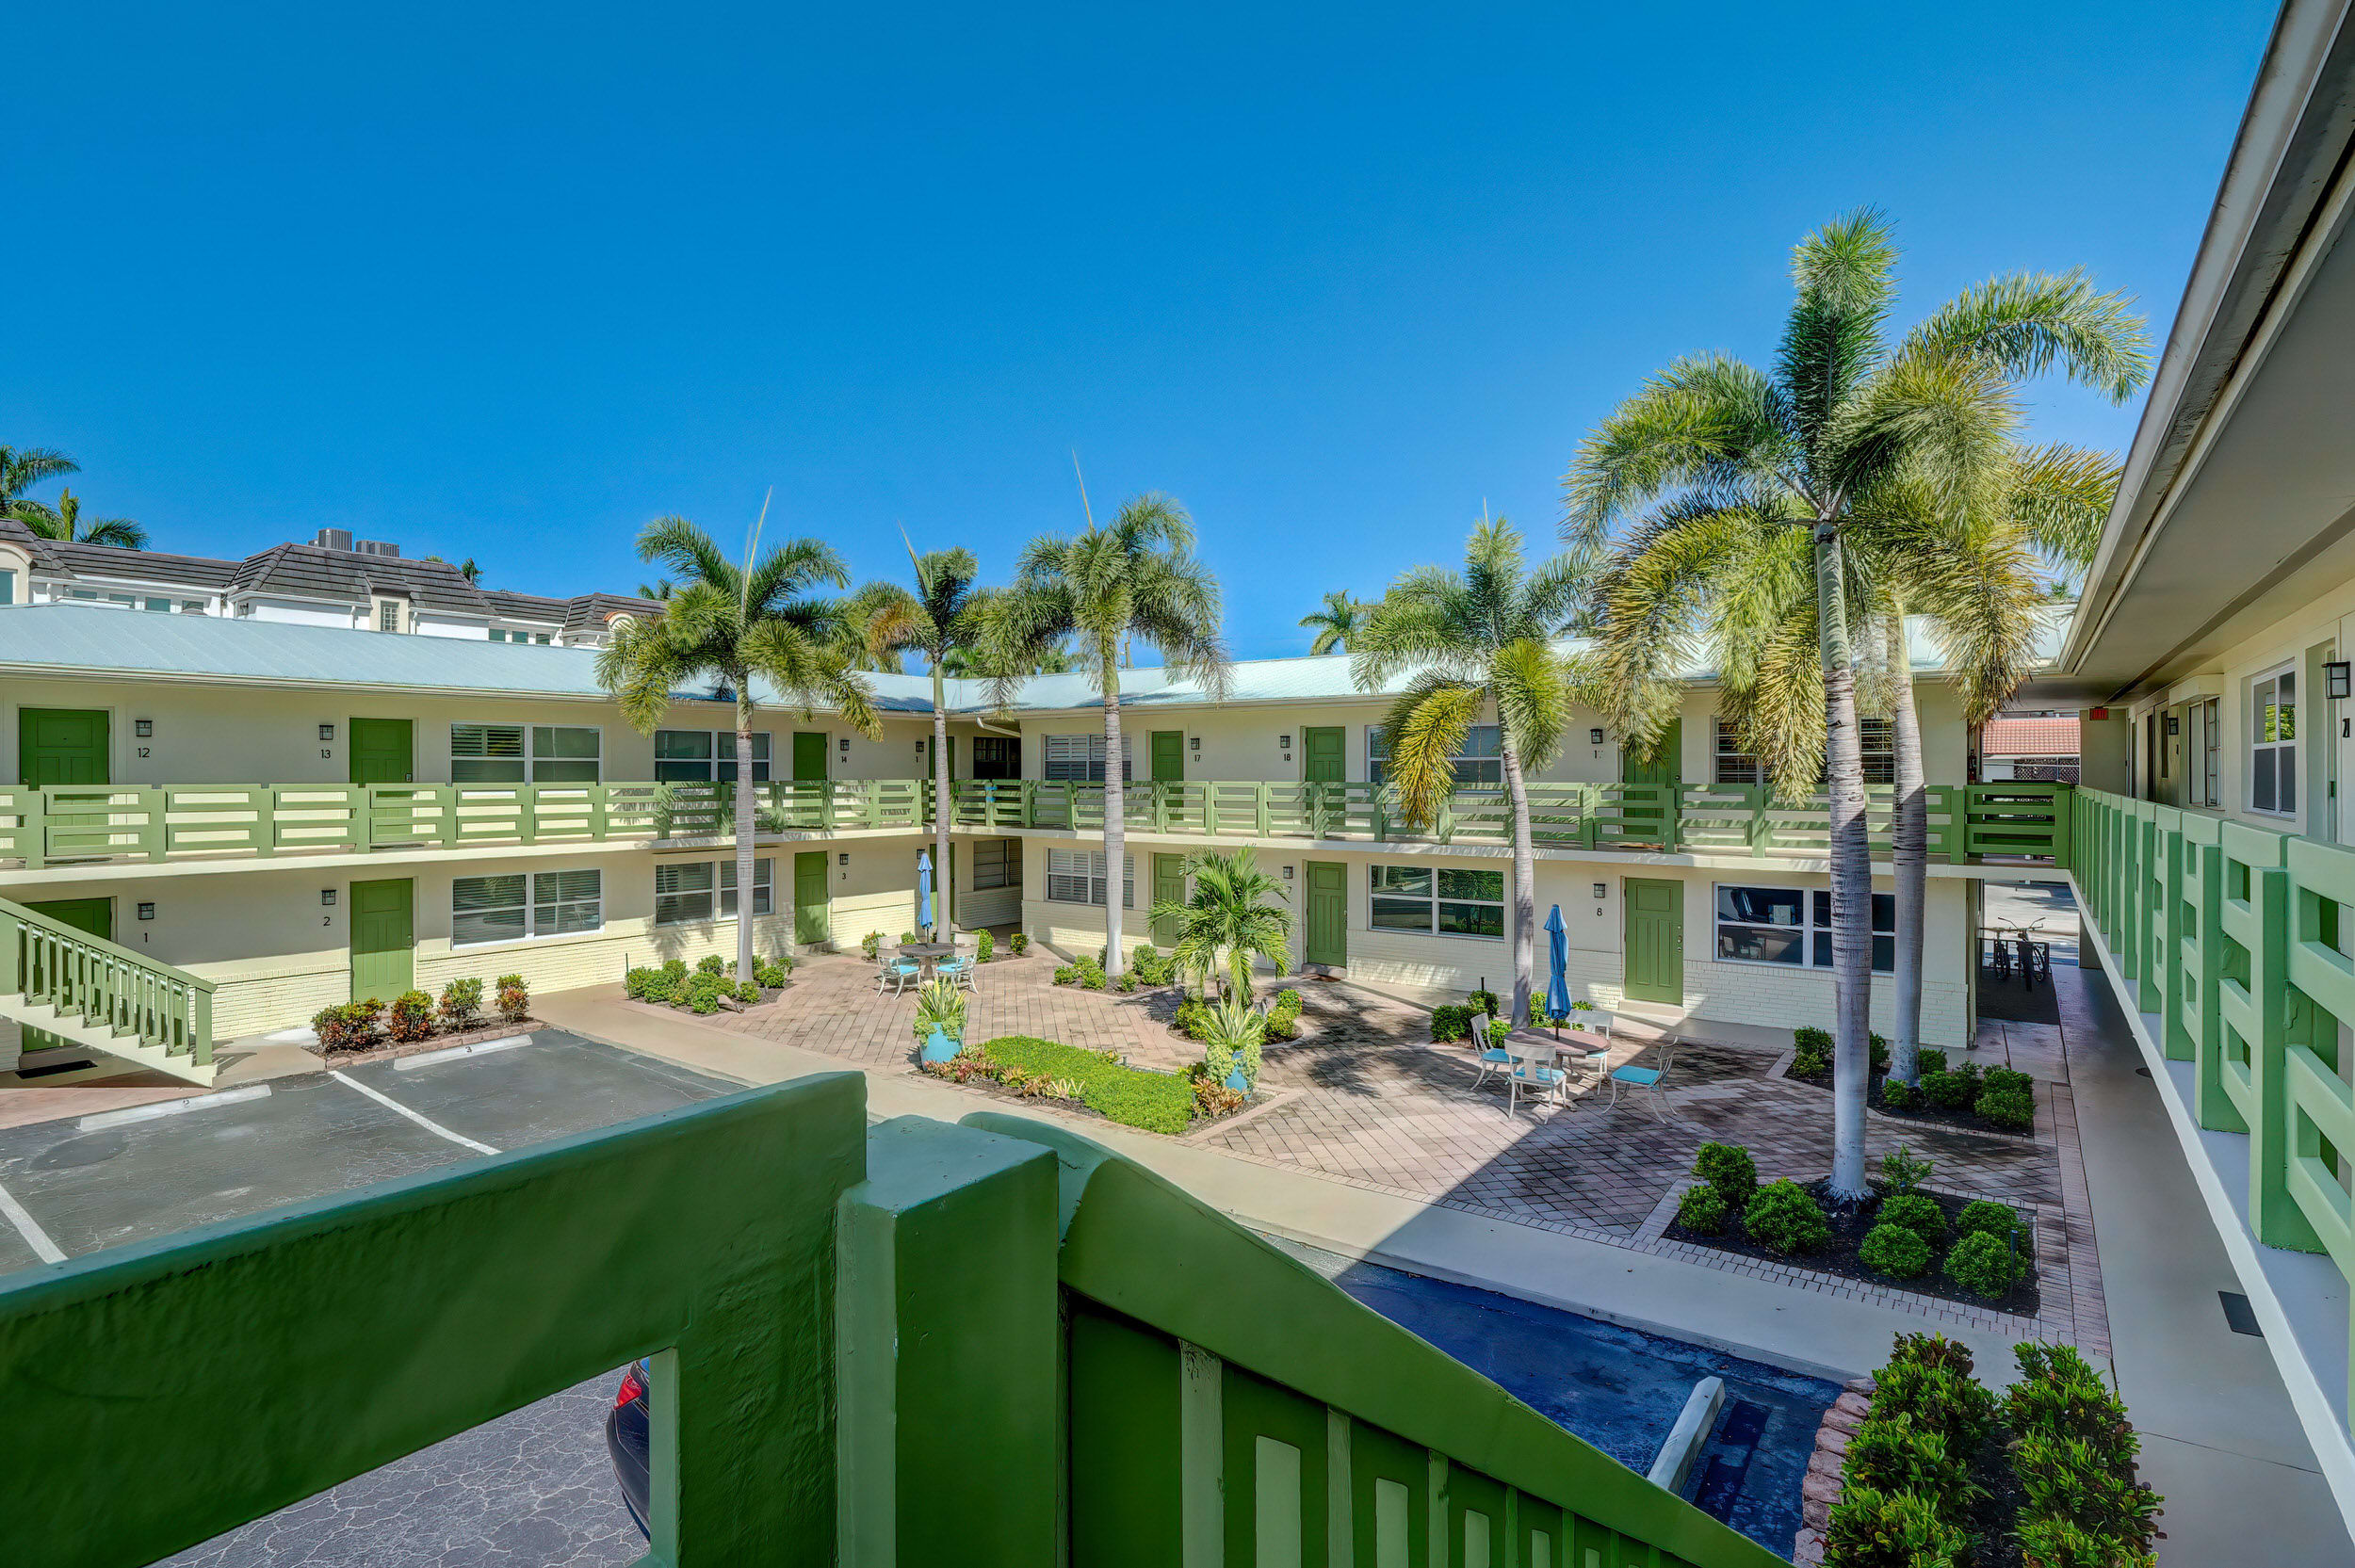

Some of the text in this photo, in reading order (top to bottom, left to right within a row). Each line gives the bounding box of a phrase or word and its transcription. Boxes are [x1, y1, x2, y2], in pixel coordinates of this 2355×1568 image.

[138, 748, 150, 758] 12
[321, 750, 331, 759] 13
[1283, 753, 1291, 762] 18
[1597, 907, 1602, 916] 8
[323, 916, 331, 926] 2
[144, 932, 148, 943] 1
